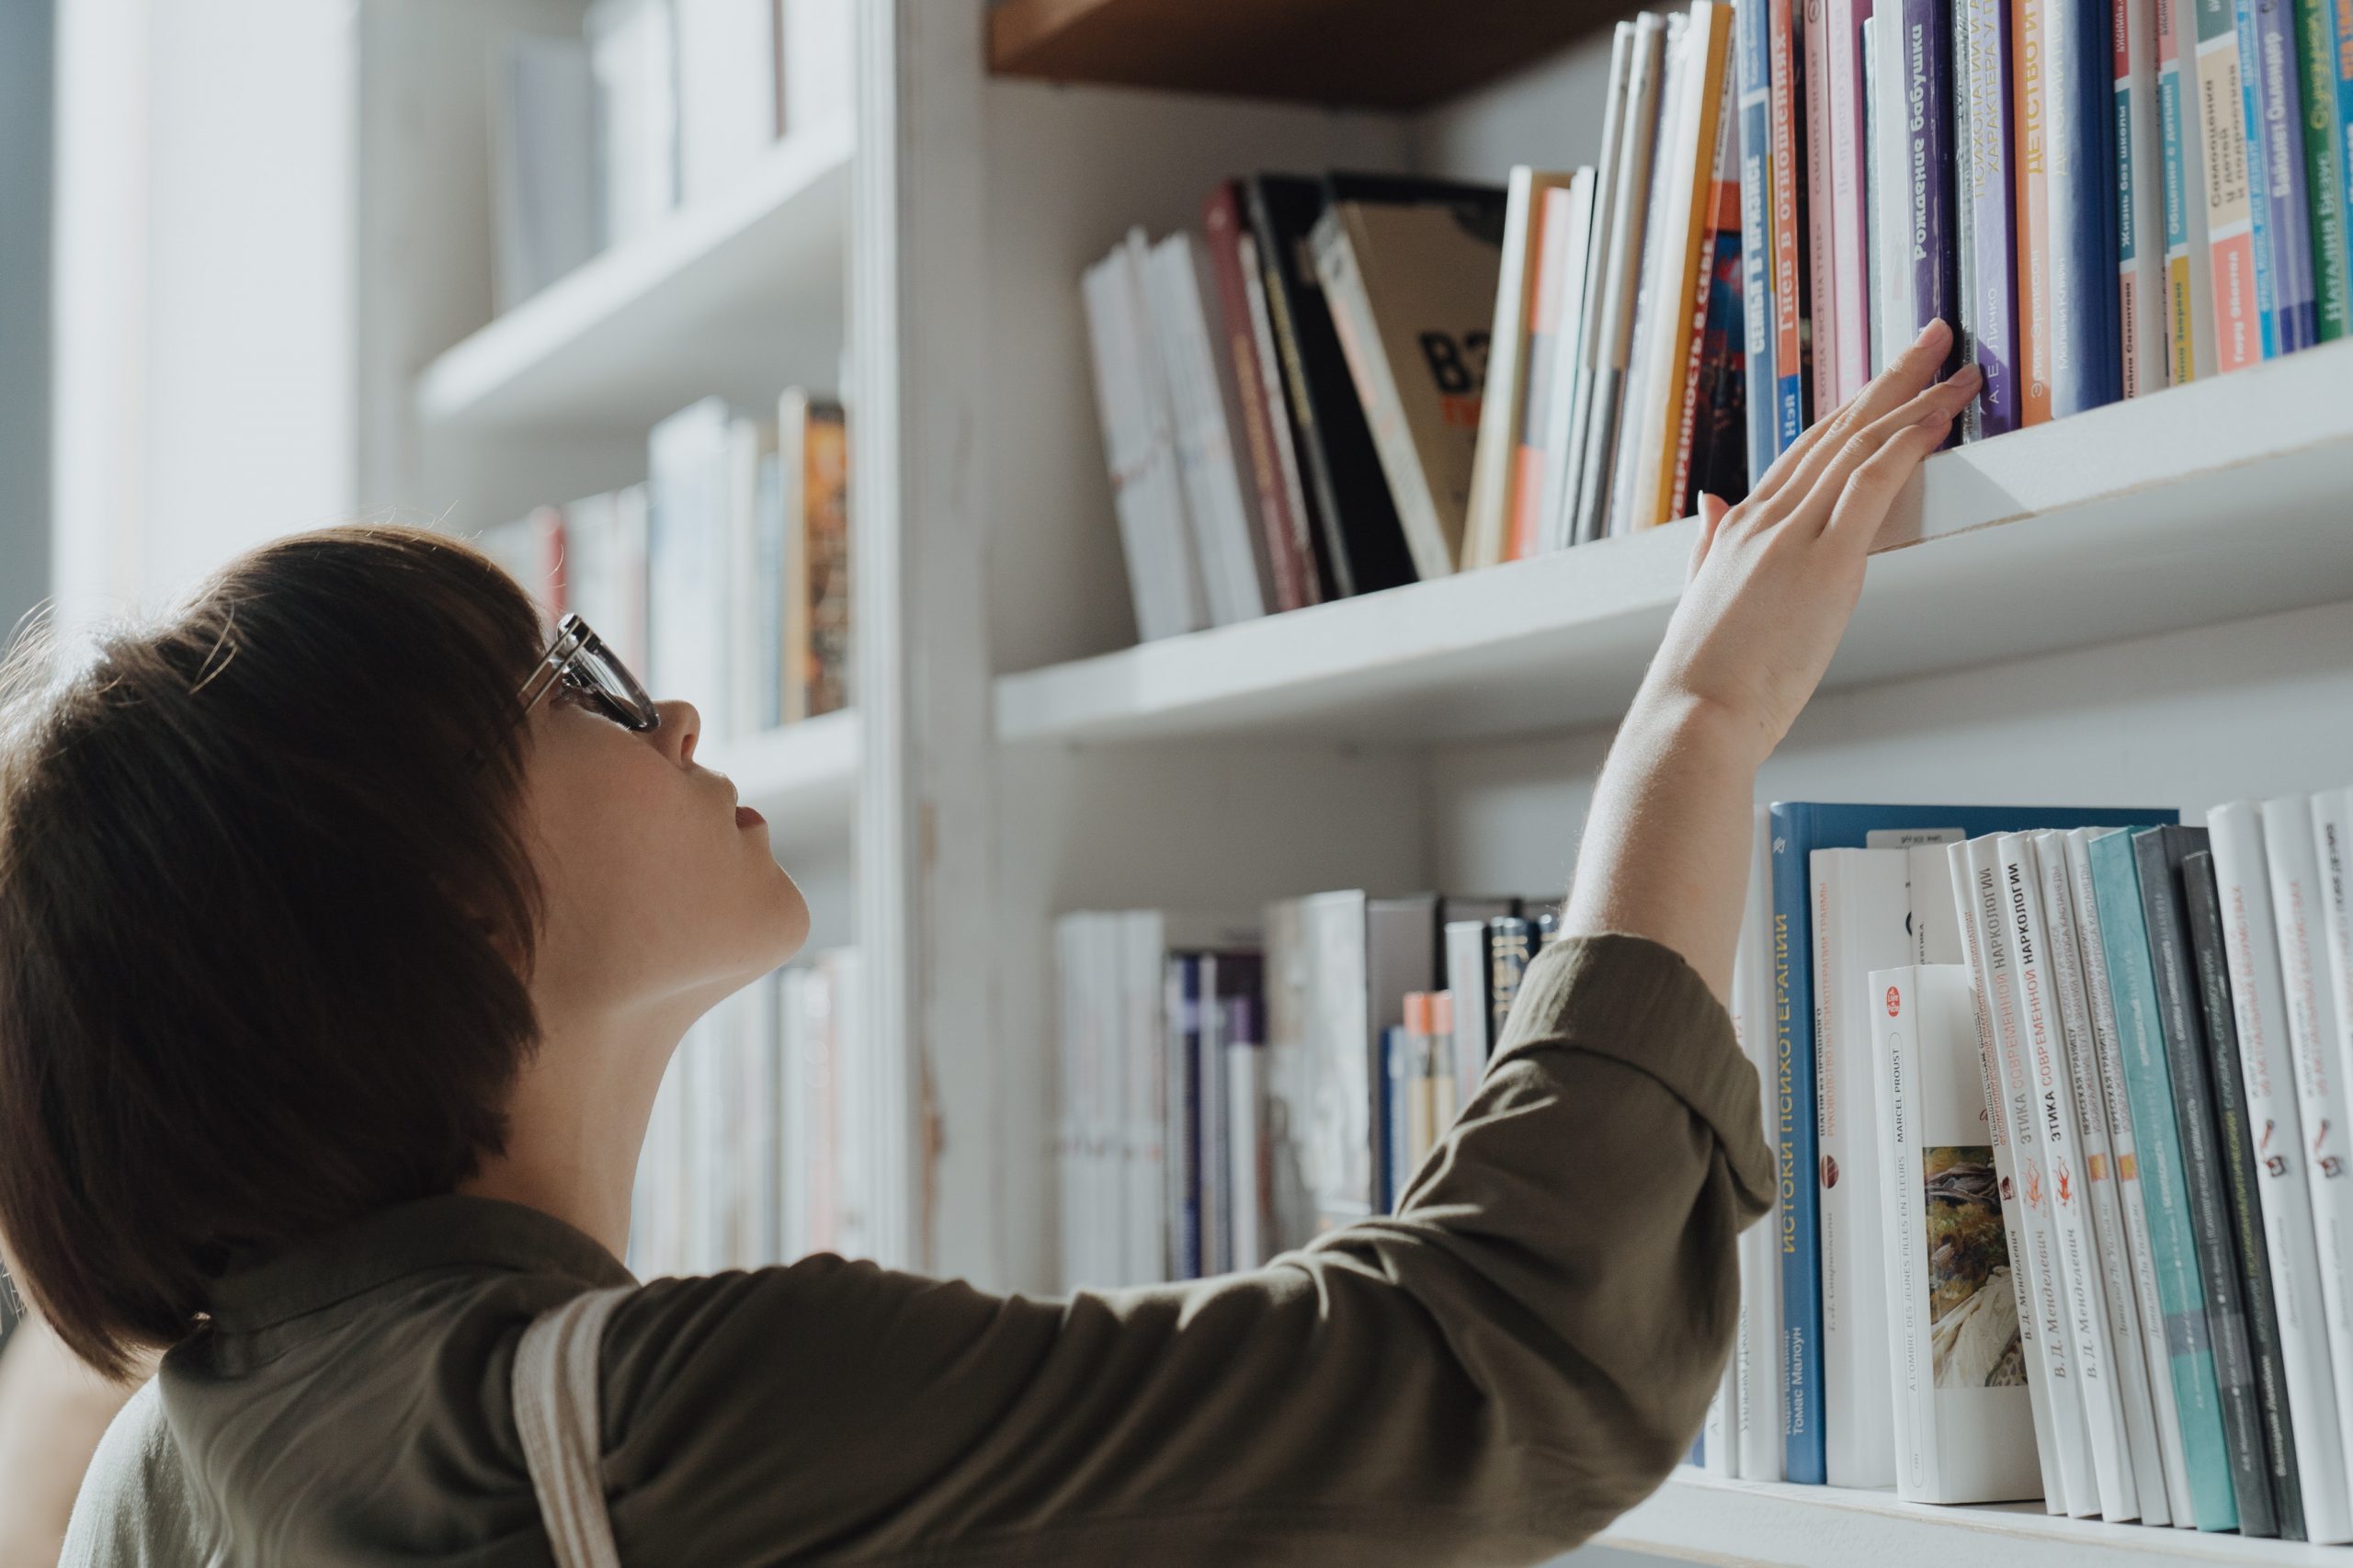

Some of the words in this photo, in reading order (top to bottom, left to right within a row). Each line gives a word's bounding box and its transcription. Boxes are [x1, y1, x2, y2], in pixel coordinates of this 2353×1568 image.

[1969, 17, 1982, 34] И
[1984, 22, 1995, 38] У
[2024, 12, 2038, 34] И
[1908, 23, 1927, 132] бабушки
[2264, 31, 2286, 121] Оклендер
[1970, 40, 1986, 199] ПСИХОПАТИИ
[1984, 41, 2000, 174] ХАРАКТЕРА
[2024, 40, 2044, 176] ДЕТСТВО
[2118, 105, 2128, 159] школы
[1813, 117, 1822, 195] САМАНТА
[2119, 164, 2129, 191] без
[2270, 123, 2290, 199] Вайолет
[1745, 154, 1763, 250] КРИЗИСЕ
[1912, 138, 1929, 261] Рождение
[2120, 194, 2131, 248] Жизнь
[2166, 160, 2180, 236] Общение
[1747, 256, 1764, 273] В
[1780, 232, 1792, 249] в
[1696, 237, 1713, 304] СЕБЕ
[1779, 261, 1795, 331] Гнев
[2029, 249, 2046, 339] Эриксон
[1747, 280, 1766, 355] СЕМЬЯ
[1986, 288, 2000, 350] Личко
[1987, 357, 2000, 379] Е.
[1988, 383, 2000, 404] А.
[2030, 343, 2046, 399] Эрик
[1784, 393, 1798, 437] Нэй
[1818, 881, 1830, 933] ТРАВМЫ
[1980, 867, 2007, 971] НАРКОЛОГИИ
[2006, 862, 2036, 965] НАРКОЛОГИИ
[2051, 865, 2070, 927] КАСТАНЕДЫ
[1821, 937, 1833, 1030] ПСИХОТЕРАПИИ
[1775, 913, 1793, 1134] ПСИХОТЕРАПИИ
[1994, 974, 2024, 1090] СОВРЕМЕННОЙ
[2024, 970, 2052, 1087] СОВРЕМЕННОЙ
[1824, 1051, 1836, 1137] РУКОВОДСТВО
[1892, 1048, 1902, 1093] PROUST
[1894, 1096, 1904, 1143] MARCEL
[2014, 1094, 2032, 1145] ЭТИКА
[2043, 1091, 2062, 1142] ЭТИКА
[2074, 1076, 2092, 1136] ПЕРЕСЕКАЯ
[2105, 1075, 2121, 1136] ПЕРЕСЕКАЯ
[1780, 1141, 1796, 1255] ИСТОКИ
[1896, 1155, 1907, 1199] FLEURS
[1899, 1201, 1909, 1217] EN
[1900, 1220, 1911, 1256] FILLES
[1903, 1260, 1913, 1302] JEUNES
[2009, 1230, 2028, 1307] Менделевич
[2034, 1231, 2060, 1335] Менделевич
[2066, 1228, 2091, 1335] Менделевич
[1904, 1305, 1915, 1328] DES
[1790, 1326, 1804, 1385] Малоун
[1905, 1332, 1916, 1381] L'OMBRE
[2051, 1340, 2063, 1358] Д.
[2053, 1363, 2066, 1379] В.
[2083, 1341, 2096, 1358] Д.
[2086, 1364, 2097, 1379] В.
[1791, 1389, 1804, 1437] Томас
